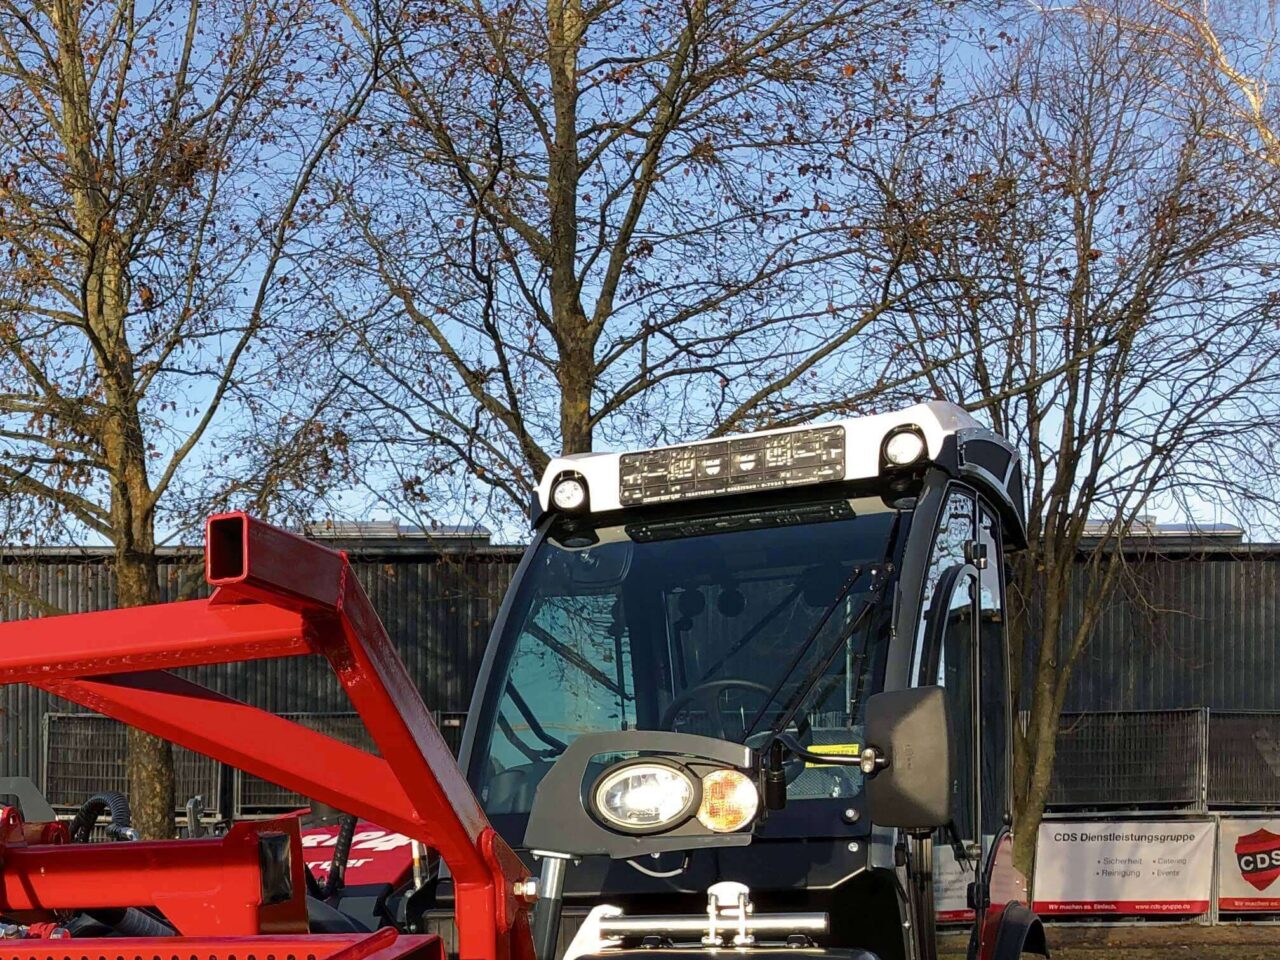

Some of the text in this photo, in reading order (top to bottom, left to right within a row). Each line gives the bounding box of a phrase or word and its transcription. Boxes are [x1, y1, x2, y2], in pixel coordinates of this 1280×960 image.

[1054, 832, 1196, 844] CDS Dienstleistungsgruppe
[1102, 857, 1143, 866] Sicherheit
[1240, 849, 1280, 871] CDS
[1101, 869, 1141, 878] Reinigung
